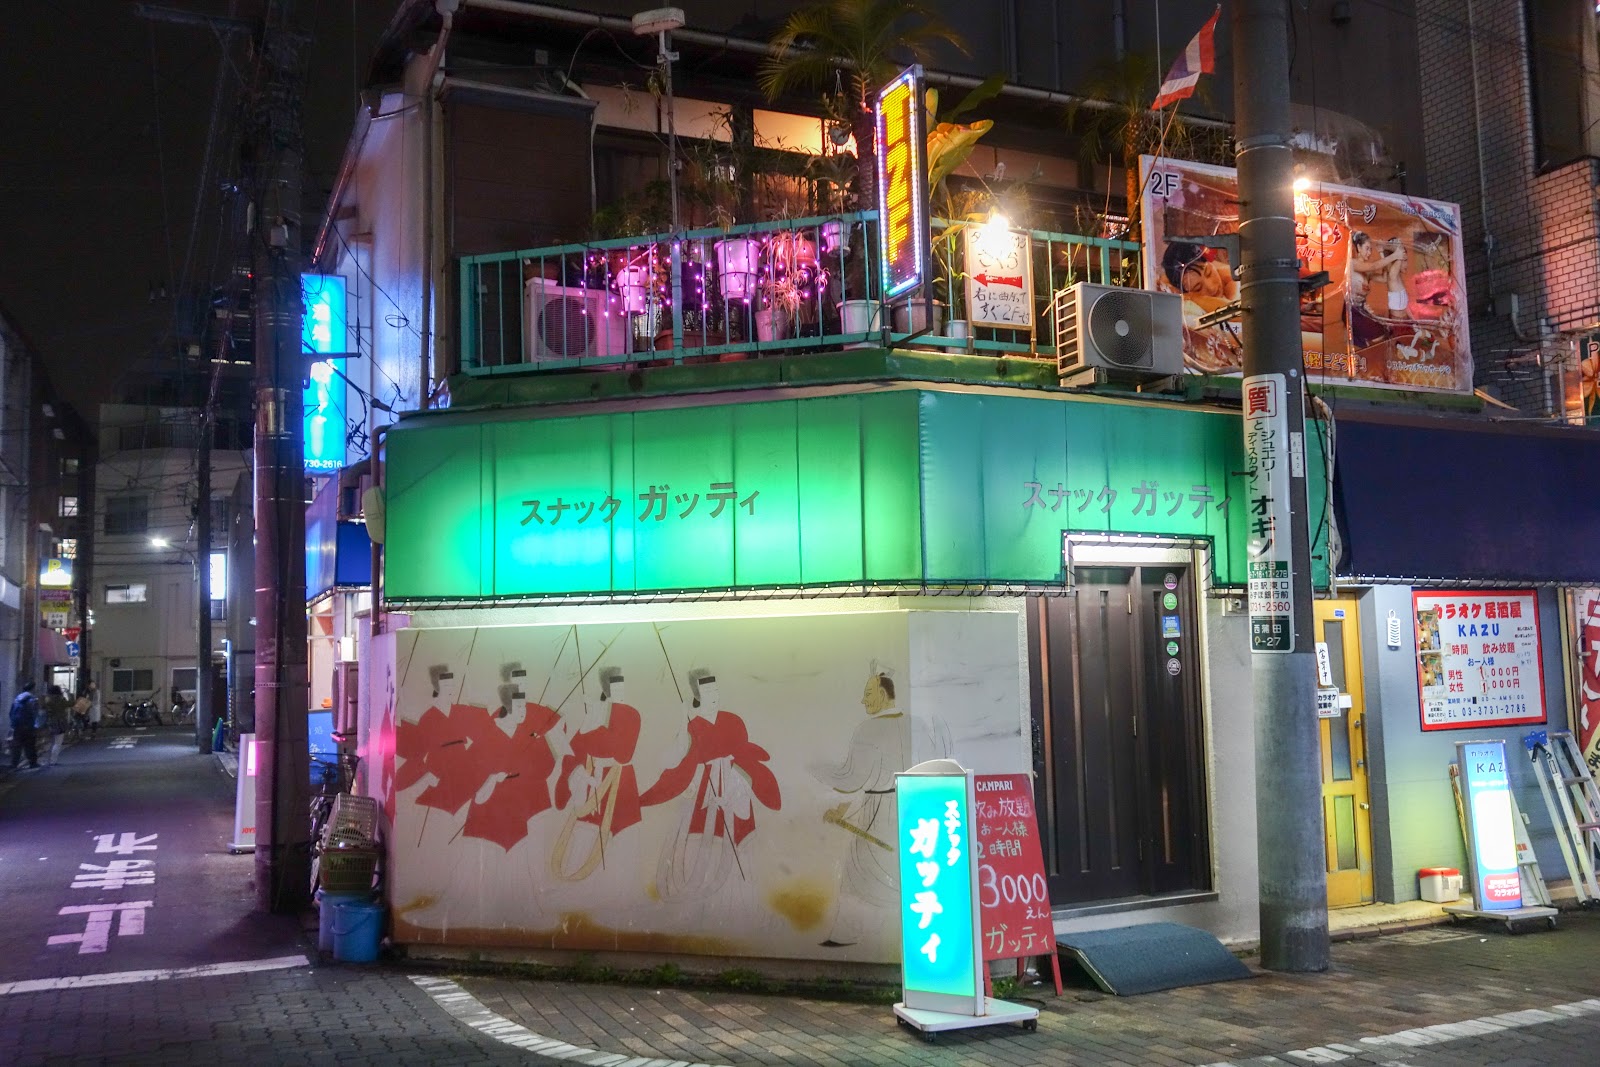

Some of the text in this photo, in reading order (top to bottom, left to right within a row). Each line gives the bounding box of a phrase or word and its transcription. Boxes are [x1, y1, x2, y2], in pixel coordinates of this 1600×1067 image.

[1150, 171, 1182, 198] 2F
[1248, 387, 1271, 416] 質
[1254, 419, 1264, 431] と
[1261, 429, 1276, 482] ジュエリー
[520, 482, 760, 526] スナック ガッティ
[1022, 480, 1232, 519] スナック ガッティ
[1250, 494, 1276, 558] オギノ
[1249, 601, 1291, 612] 731-2560
[1253, 624, 1282, 634] 西蒲田
[1458, 623, 1499, 637] KAZU
[1452, 641, 1515, 655] 時間 飲み放題
[1467, 656, 1495, 667] お一人様
[1448, 669, 1464, 680] 男性
[1449, 682, 1464, 693] 女性
[1462, 703, 1526, 717] 03-3731-2786
[976, 780, 1014, 792] CAMPARI
[981, 821, 1029, 838] お一人様
[989, 840, 1023, 858] 時間
[909, 799, 961, 964] スナック ガッティ
[978, 863, 1048, 909] 3000
[1026, 906, 1050, 920] えん
[986, 923, 1049, 954] ガッティ
